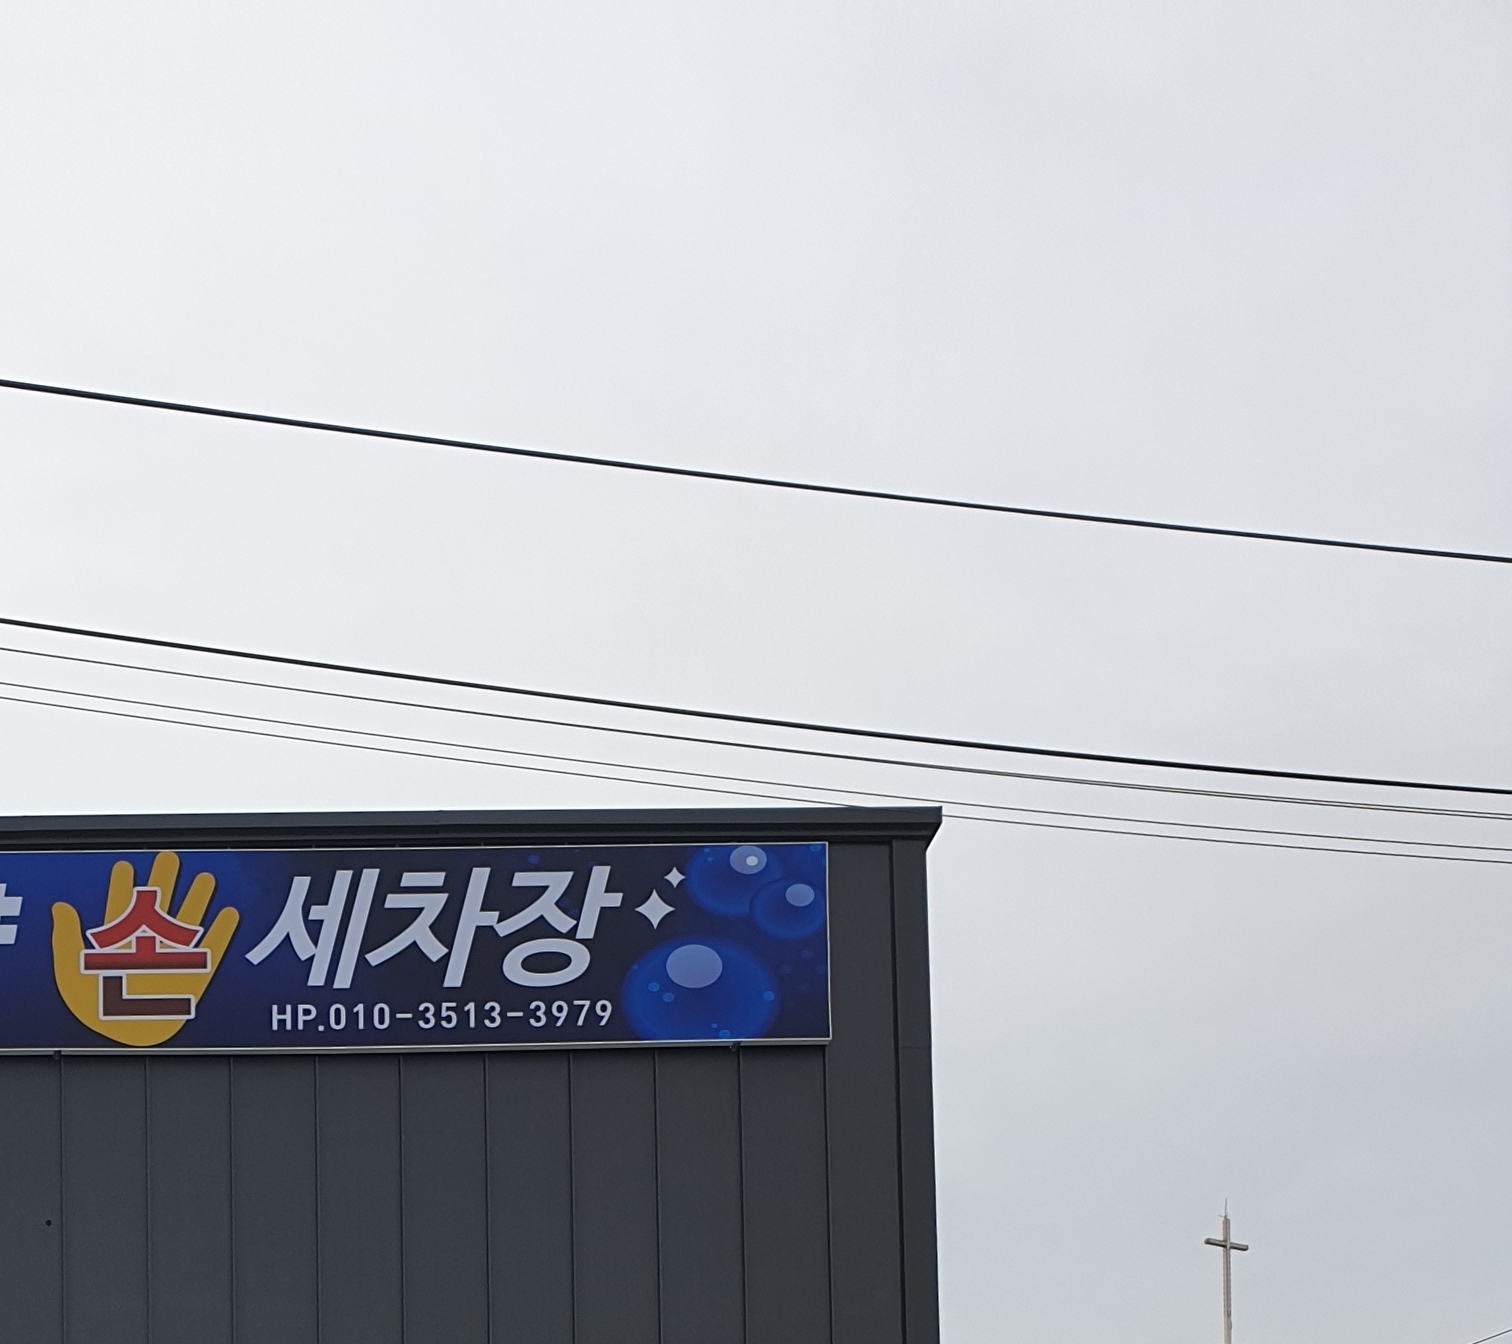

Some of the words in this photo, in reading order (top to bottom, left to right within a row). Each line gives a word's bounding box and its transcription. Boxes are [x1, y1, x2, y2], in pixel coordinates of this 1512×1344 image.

[79, 886, 212, 1021] 손
[244, 864, 624, 990] 세차장
[270, 999, 614, 1033] HP.010-3513-3979
